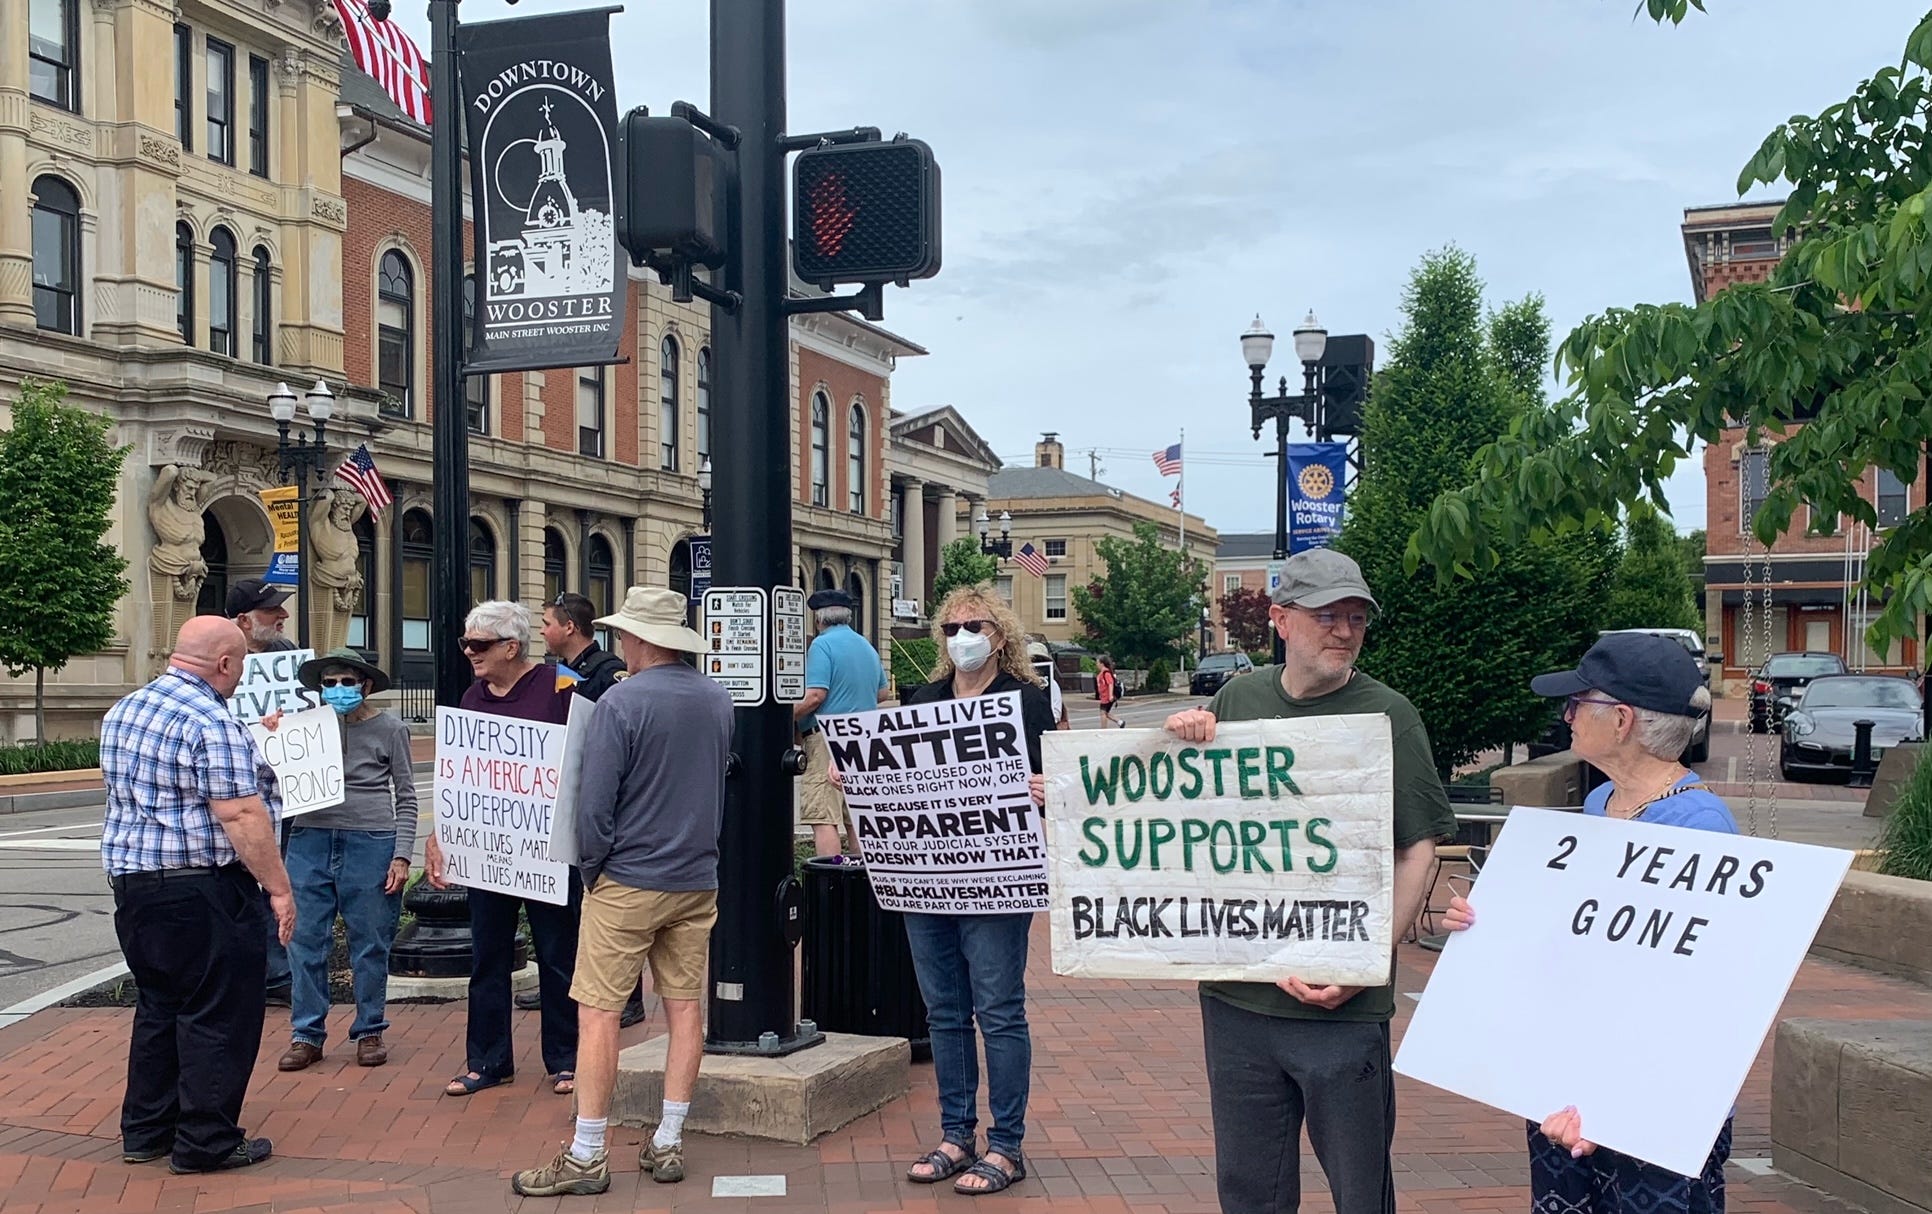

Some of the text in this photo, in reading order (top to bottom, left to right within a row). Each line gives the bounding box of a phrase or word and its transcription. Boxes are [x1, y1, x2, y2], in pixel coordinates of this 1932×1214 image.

[474, 61, 605, 114] DOWNTOWN
[487, 297, 612, 321] WOOSTER
[485, 323, 610, 340] MAIN STREET WOOSTER INC
[267, 503, 294, 512] Mental
[277, 511, 298, 520] HEALT
[1291, 499, 1341, 513] Wooster
[1296, 512, 1335, 527] Rotary
[238, 654, 307, 686] ACK
[231, 687, 316, 718] IVES
[818, 696, 1014, 739] YES, ALL LIVES
[264, 723, 325, 767] CISM
[444, 714, 549, 760] DIVERSITY
[827, 721, 1023, 772] MATTER
[440, 758, 454, 779] IS
[840, 759, 1024, 784] BUT WE'RE FOCUSED ON THE
[844, 772, 1025, 796] BLACK ONES RIGHT NOW, OK?
[1079, 745, 1303, 806] WOOSTER
[281, 765, 341, 806] RONG
[441, 788, 550, 835] SUPERPOWE
[874, 794, 993, 812] BECAUSE IT IS VERY
[859, 805, 1032, 839] APPARENT
[441, 824, 563, 864] BLACK LIVES MATT
[860, 832, 1039, 851] THAT OUR JUDICIAL SYSTEM
[864, 846, 1046, 865] DOESN'T KNOW THAT.
[1078, 816, 1338, 874] SUPPORTS
[447, 854, 556, 895] ALL LIVES MATTER
[486, 854, 513, 866] MEANS
[1546, 835, 1774, 898] 2 YEARS
[874, 883, 1049, 899] #BLACKLIVESMATTER
[997, 872, 1047, 883] EXCLAIMING
[879, 898, 900, 907] YOU
[903, 900, 922, 909] ARE
[924, 902, 951, 910] PART
[954, 901, 969, 910] OF
[972, 901, 995, 910] THE
[1072, 896, 1370, 942] BLACK LIVES MATTER
[1571, 899, 1709, 956] GONE
